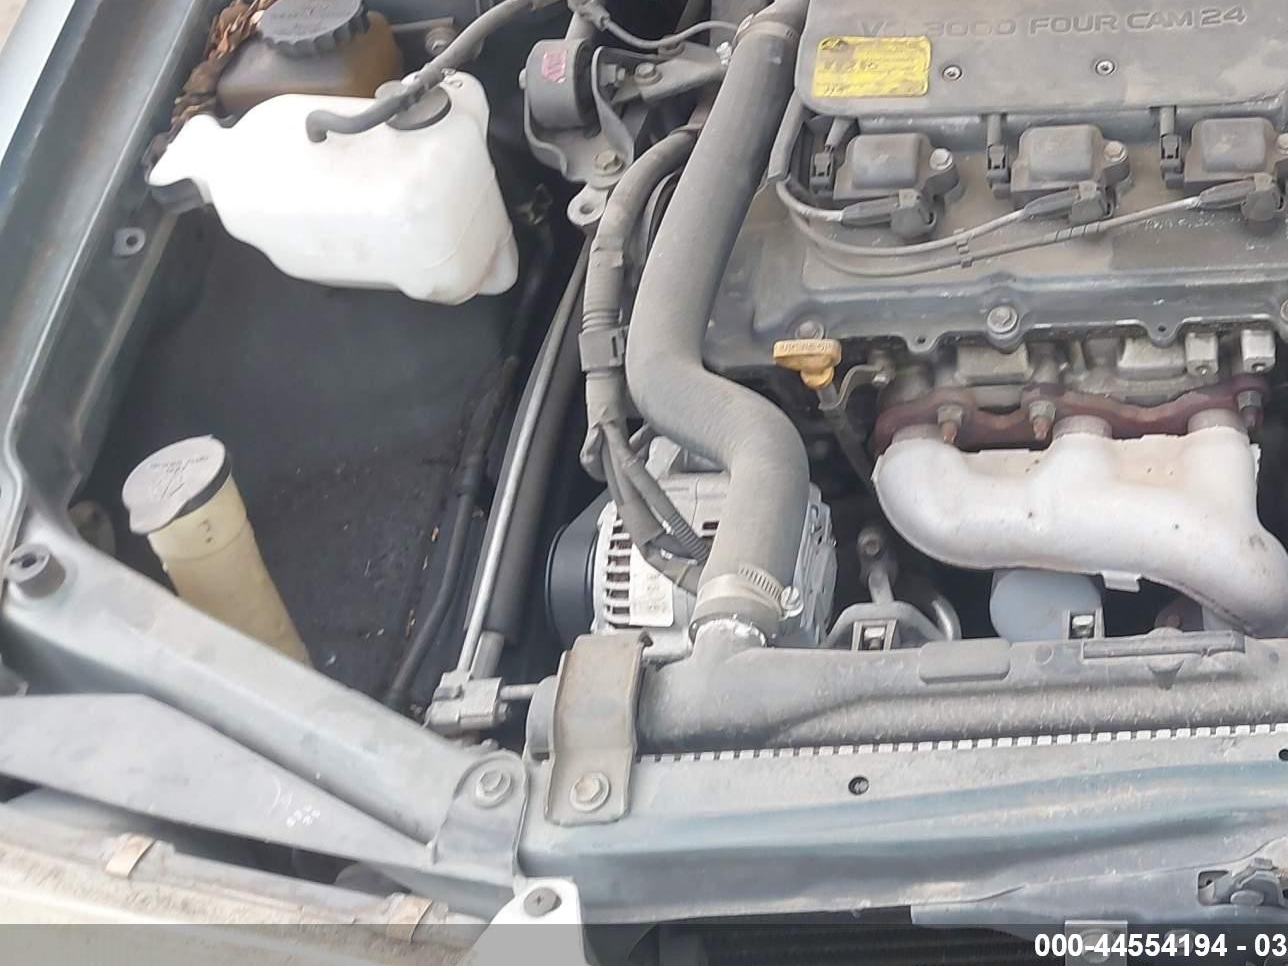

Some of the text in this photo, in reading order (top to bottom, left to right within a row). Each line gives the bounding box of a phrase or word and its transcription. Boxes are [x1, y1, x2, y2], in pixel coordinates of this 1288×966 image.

[1030, 14, 1118, 35] FOUR
[1126, 10, 1193, 30] CAM
[1200, 6, 1248, 26] 24
